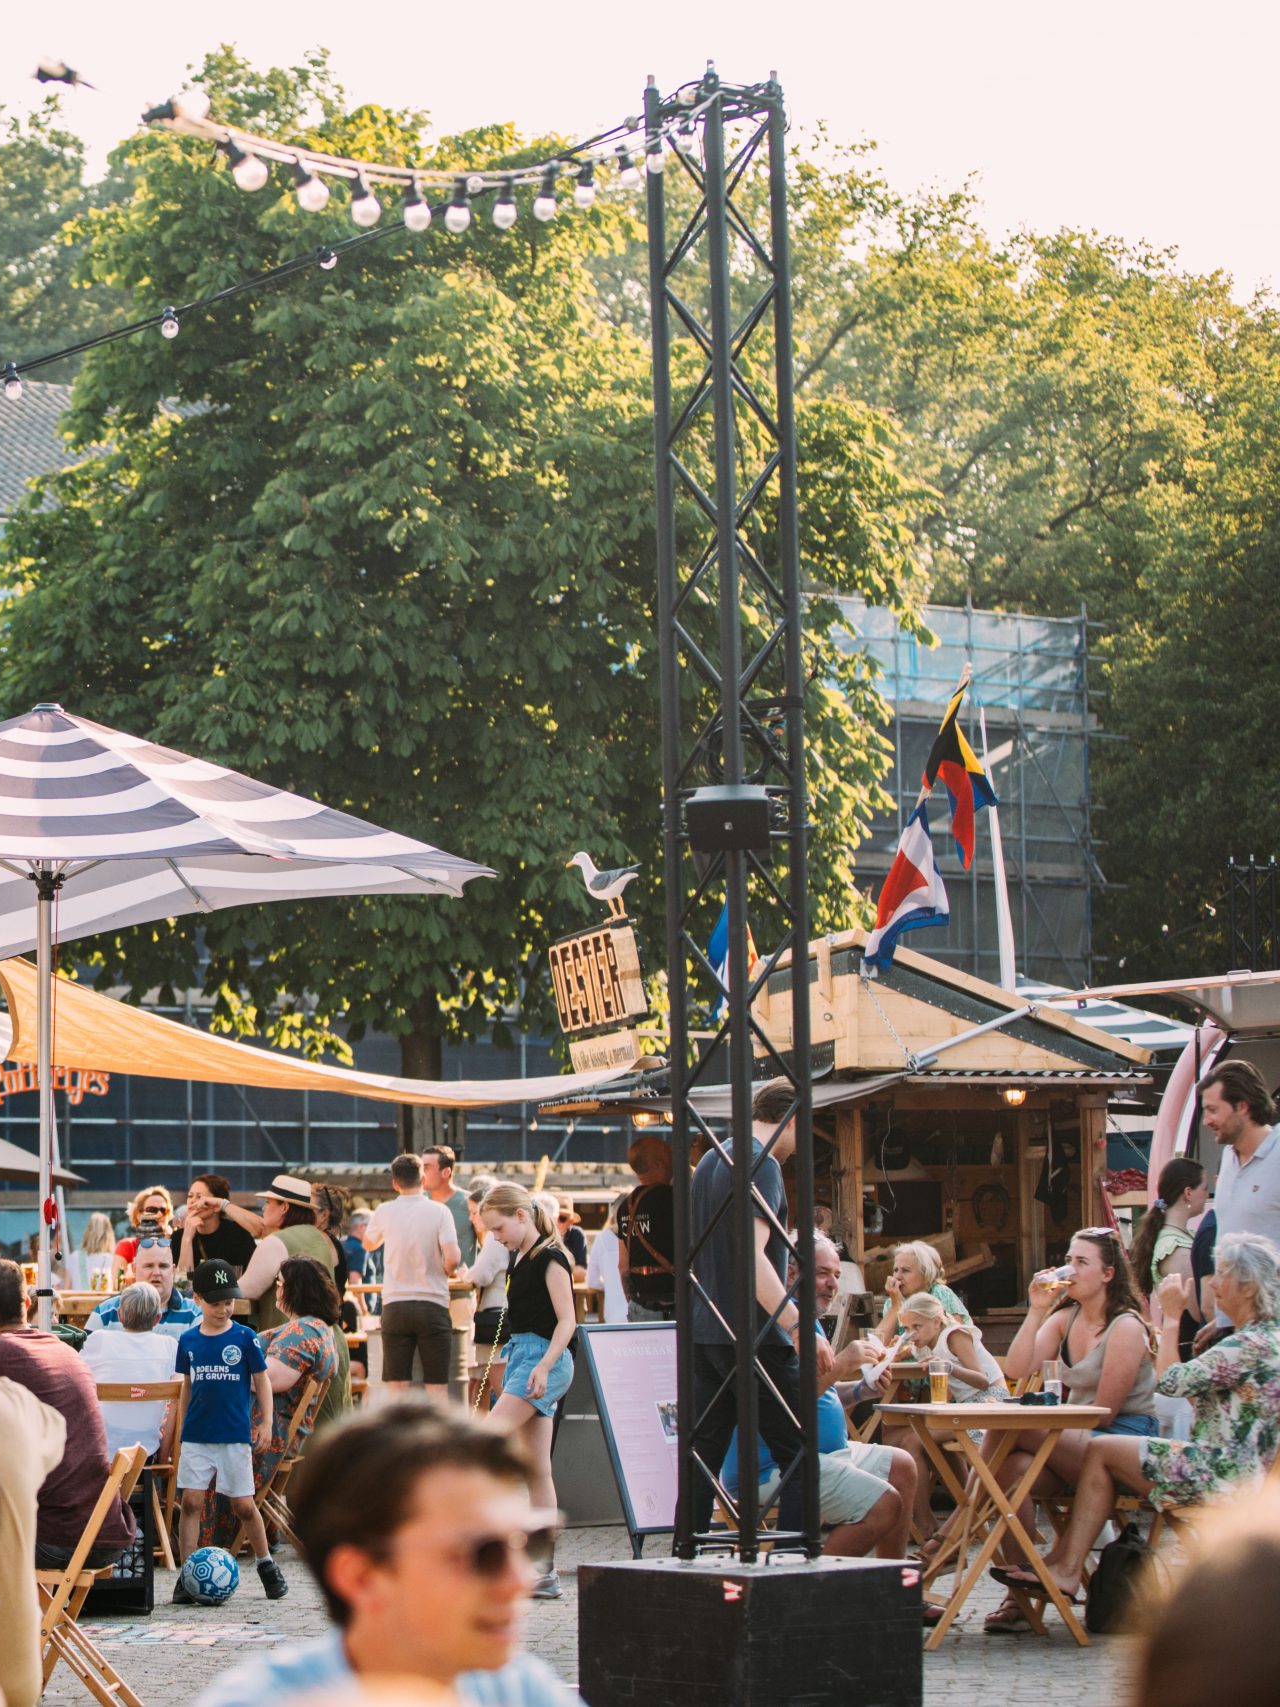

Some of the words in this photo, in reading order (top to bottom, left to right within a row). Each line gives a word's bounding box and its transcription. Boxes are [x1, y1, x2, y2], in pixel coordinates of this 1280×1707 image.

[549, 929, 628, 1033] OESTER
[613, 1344, 677, 1358] MENUKAAR
[196, 1365, 229, 1373] BOELENS
[195, 1373, 204, 1381] DE
[205, 1373, 241, 1381] GRUYTER
